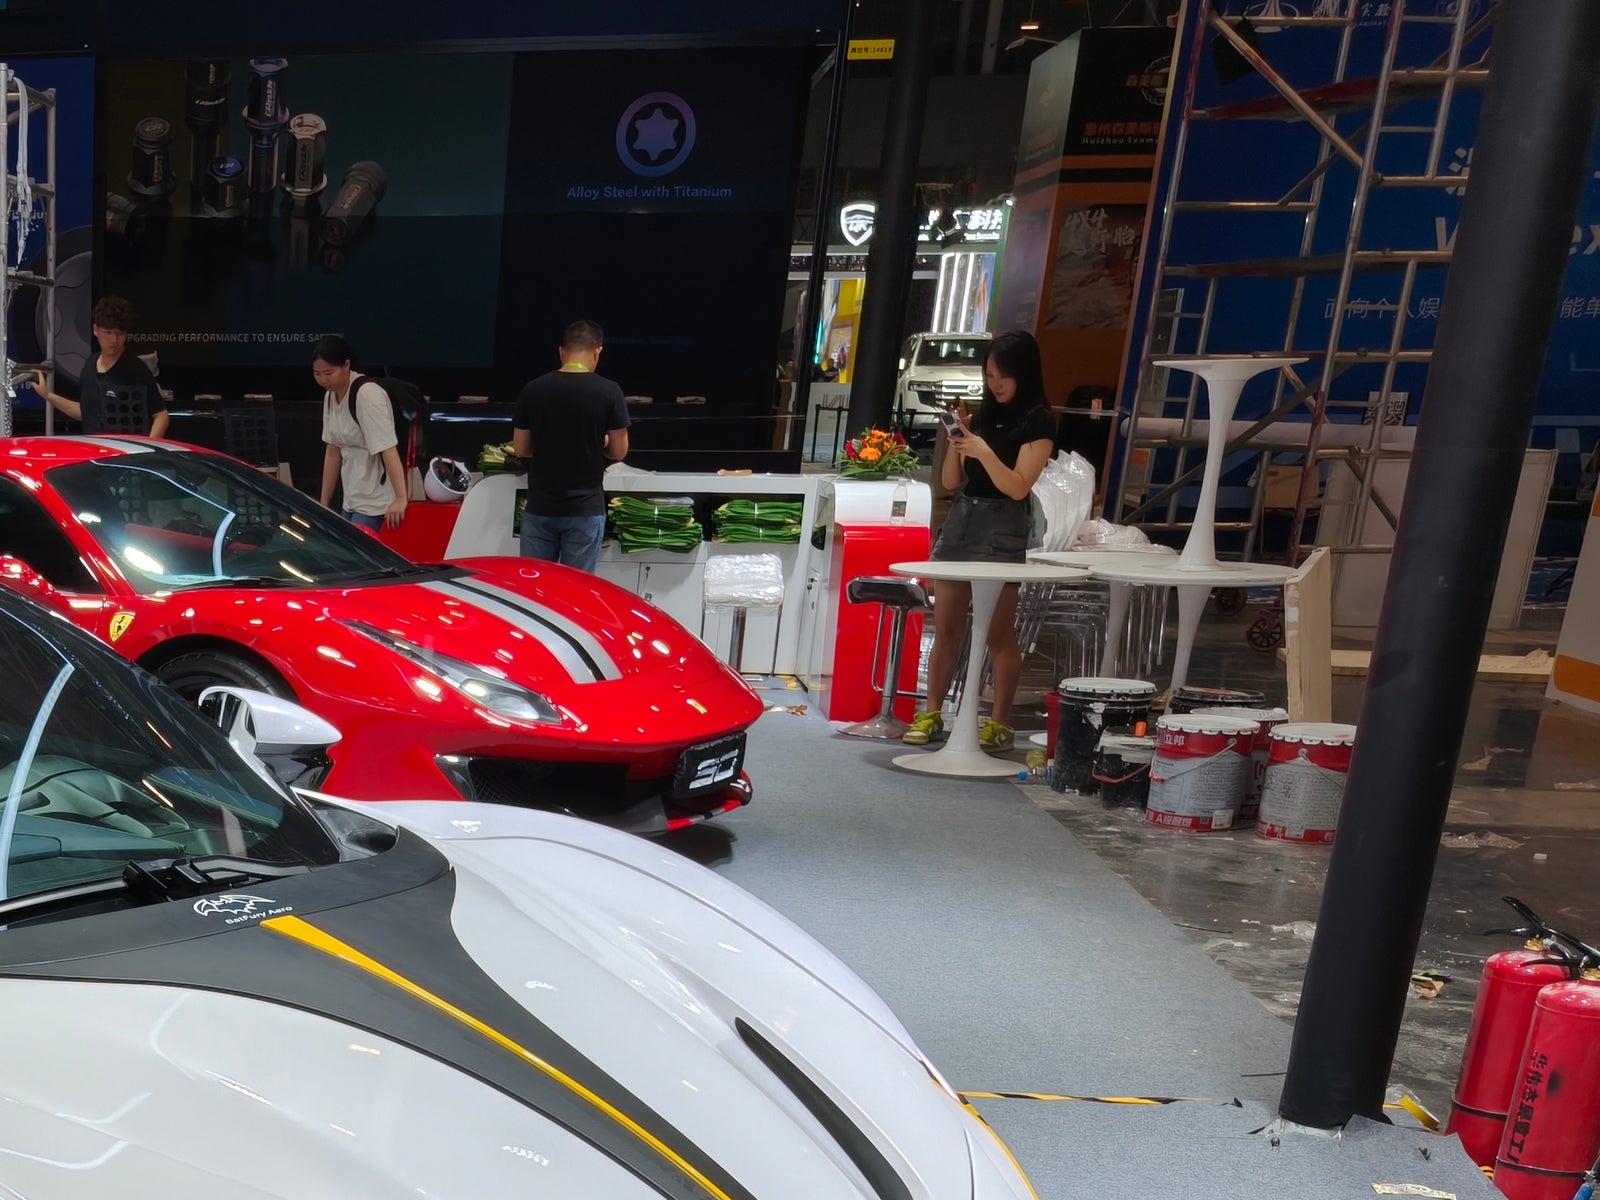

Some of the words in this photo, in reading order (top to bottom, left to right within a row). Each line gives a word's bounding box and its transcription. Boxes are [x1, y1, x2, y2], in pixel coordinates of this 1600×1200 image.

[567, 187, 600, 201] Alloy
[603, 186, 638, 198] Steel
[641, 186, 669, 198] with
[673, 185, 733, 198] Titanium
[127, 333, 177, 343] PGRADING
[178, 332, 249, 343] PERFORMANCE
[252, 332, 265, 342] TO
[267, 332, 306, 342] ENSURE
[225, 911, 267, 925] BatFury
[268, 906, 294, 916] Aero
